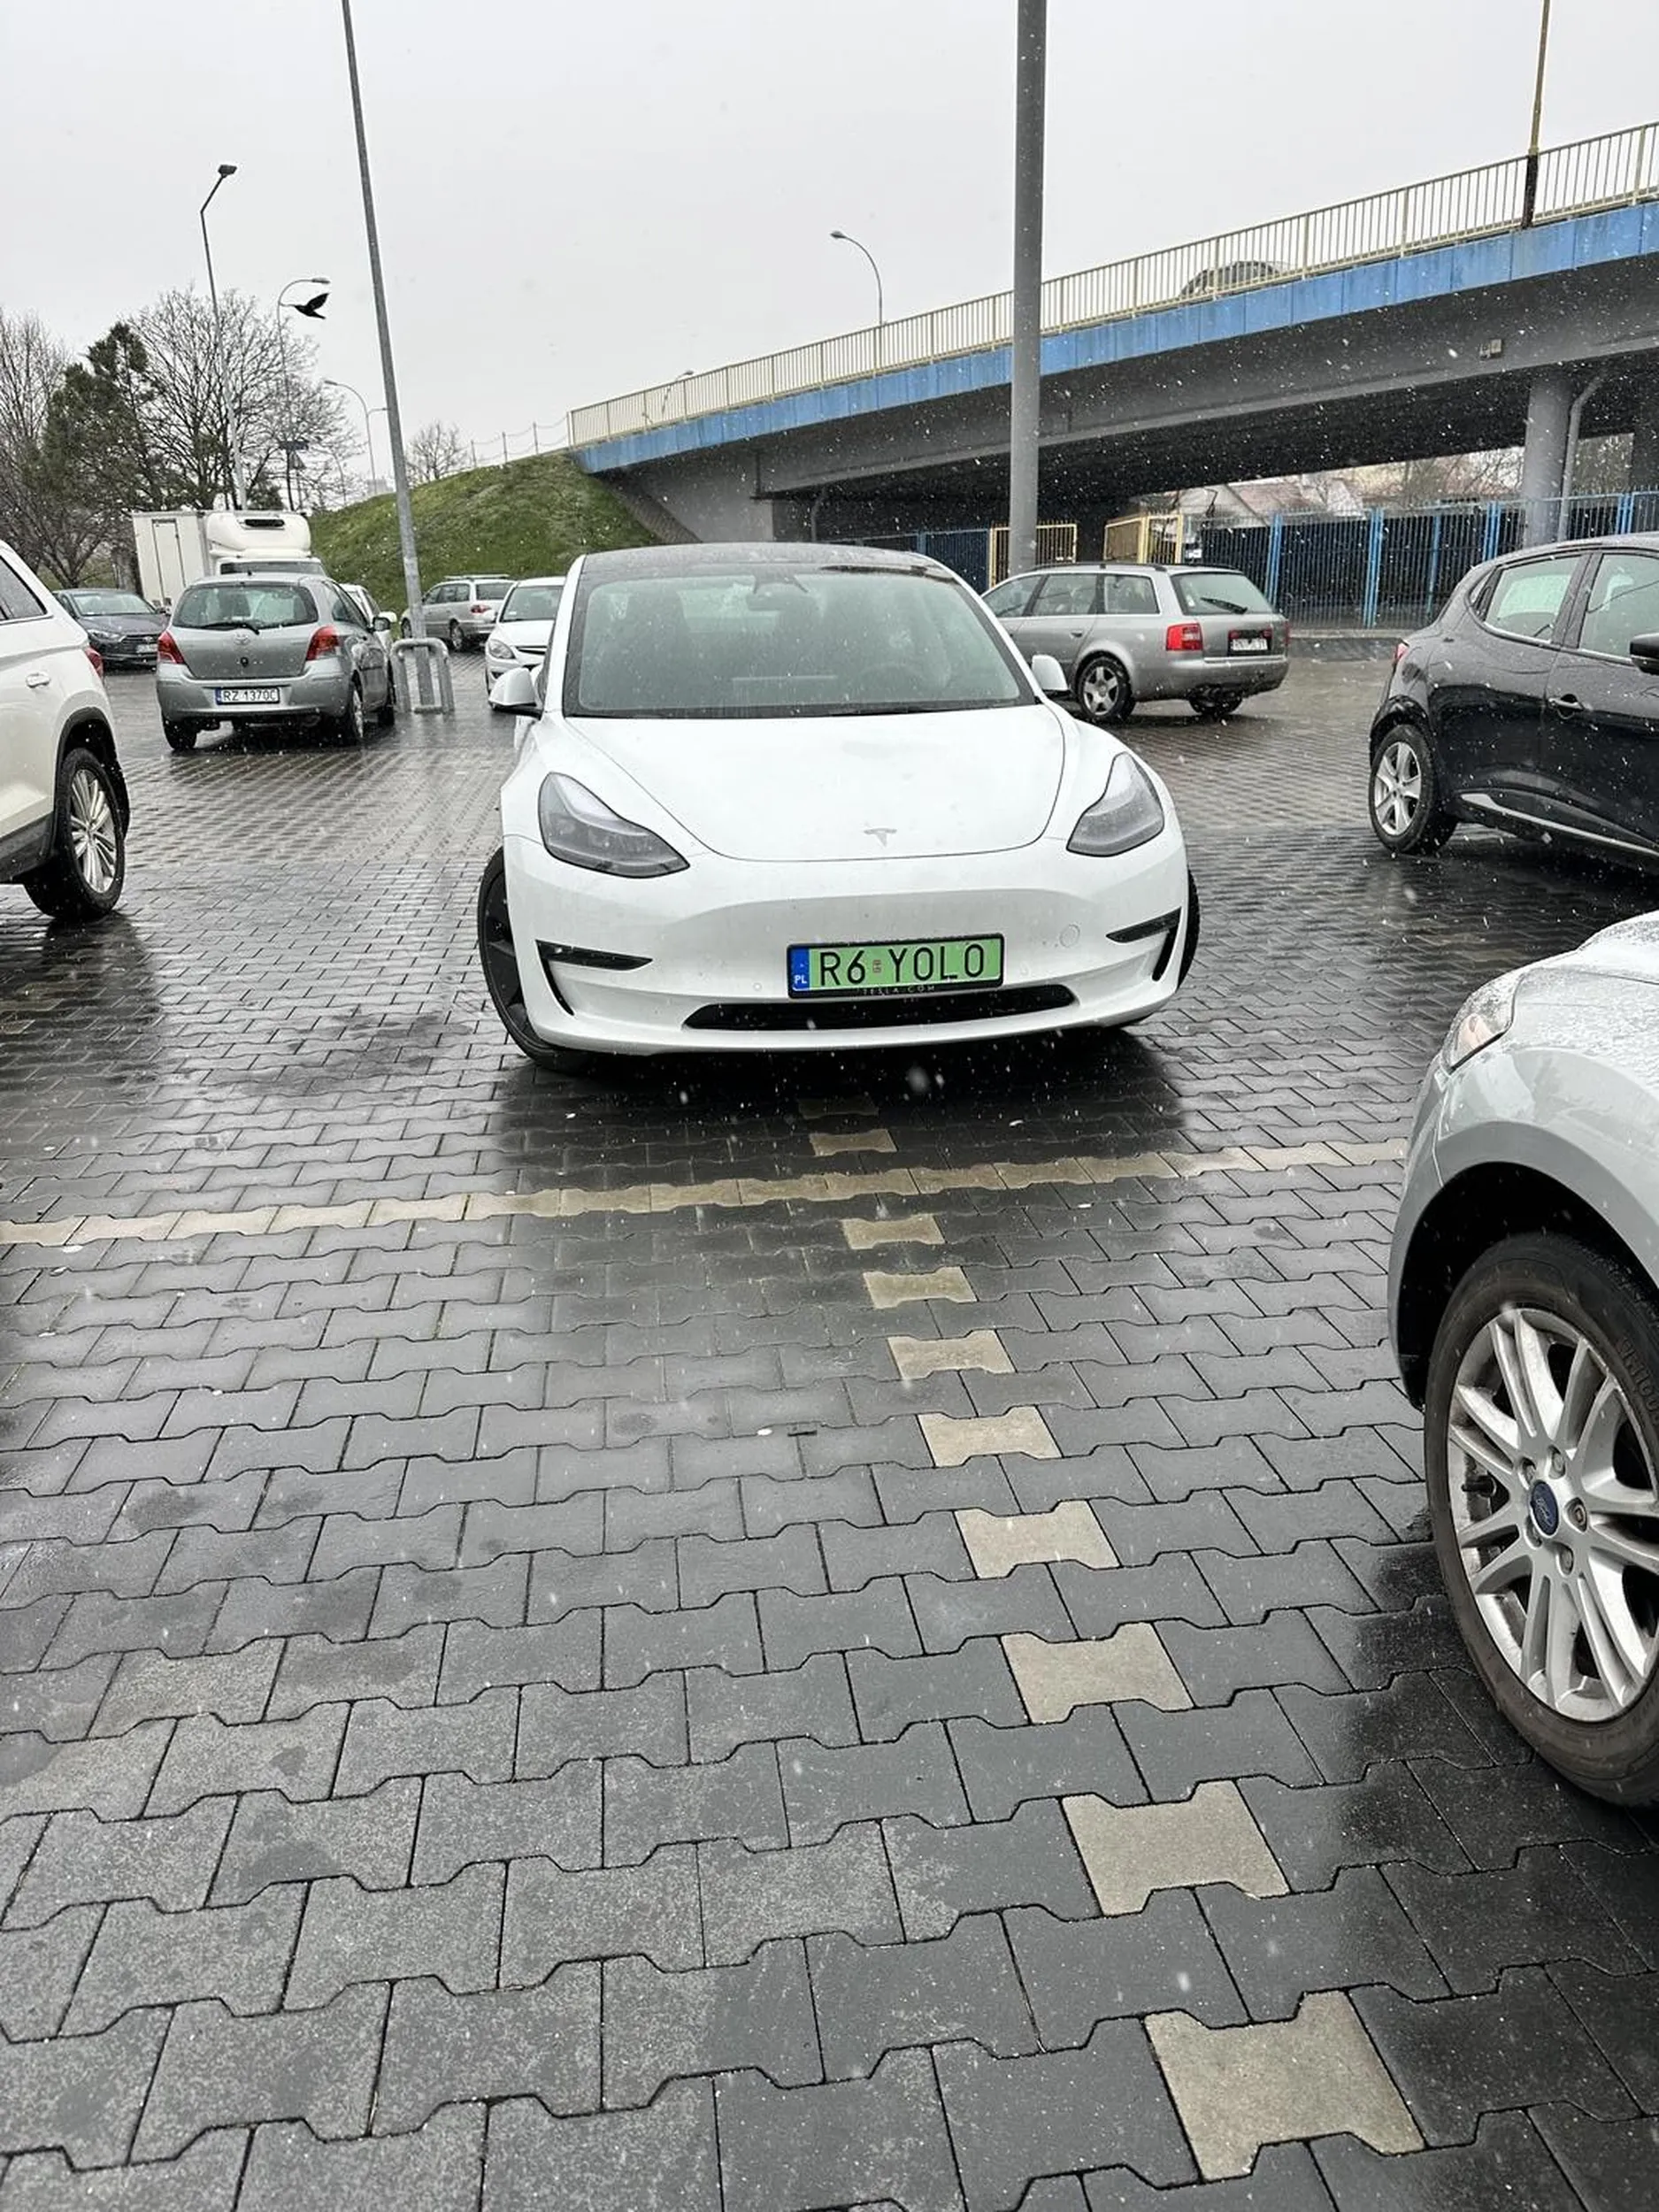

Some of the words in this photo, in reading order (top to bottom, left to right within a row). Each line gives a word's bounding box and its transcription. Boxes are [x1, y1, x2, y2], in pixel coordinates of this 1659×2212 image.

[223, 690, 239, 701] RZ
[819, 949, 866, 986] R6
[888, 943, 984, 983] YOLO
[794, 974, 808, 984] PL
